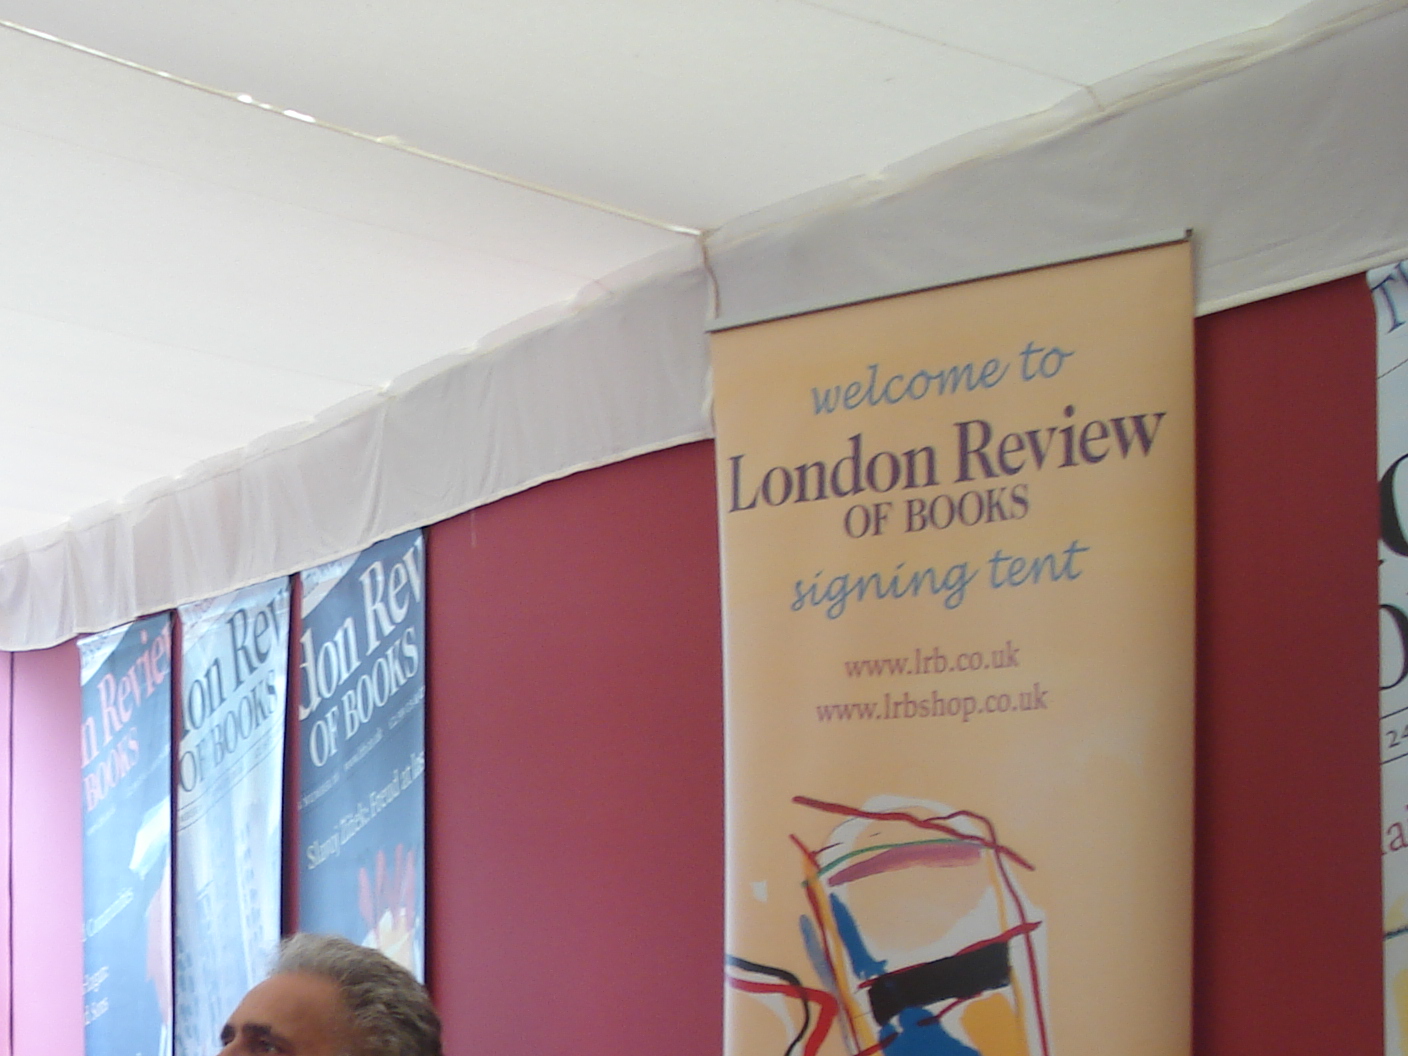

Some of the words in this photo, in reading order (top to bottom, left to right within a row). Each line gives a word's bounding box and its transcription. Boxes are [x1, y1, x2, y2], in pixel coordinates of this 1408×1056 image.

[811, 358, 1010, 416] welcome
[1019, 341, 1074, 380] to
[727, 433, 939, 513] London
[952, 404, 1168, 484] Review
[843, 502, 893, 539] OF
[903, 483, 1031, 534] BOOKS
[790, 562, 980, 620] signing
[988, 540, 1090, 588] tent
[309, 704, 340, 767] OF
[341, 626, 419, 740] BOOKS
[844, 641, 1020, 679] www.lrb.co.uk
[179, 735, 209, 792] OF
[211, 669, 278, 768] BOOKS
[816, 683, 1049, 723] www.lrbshop.co.uk
[83, 727, 139, 812] BOOKS
